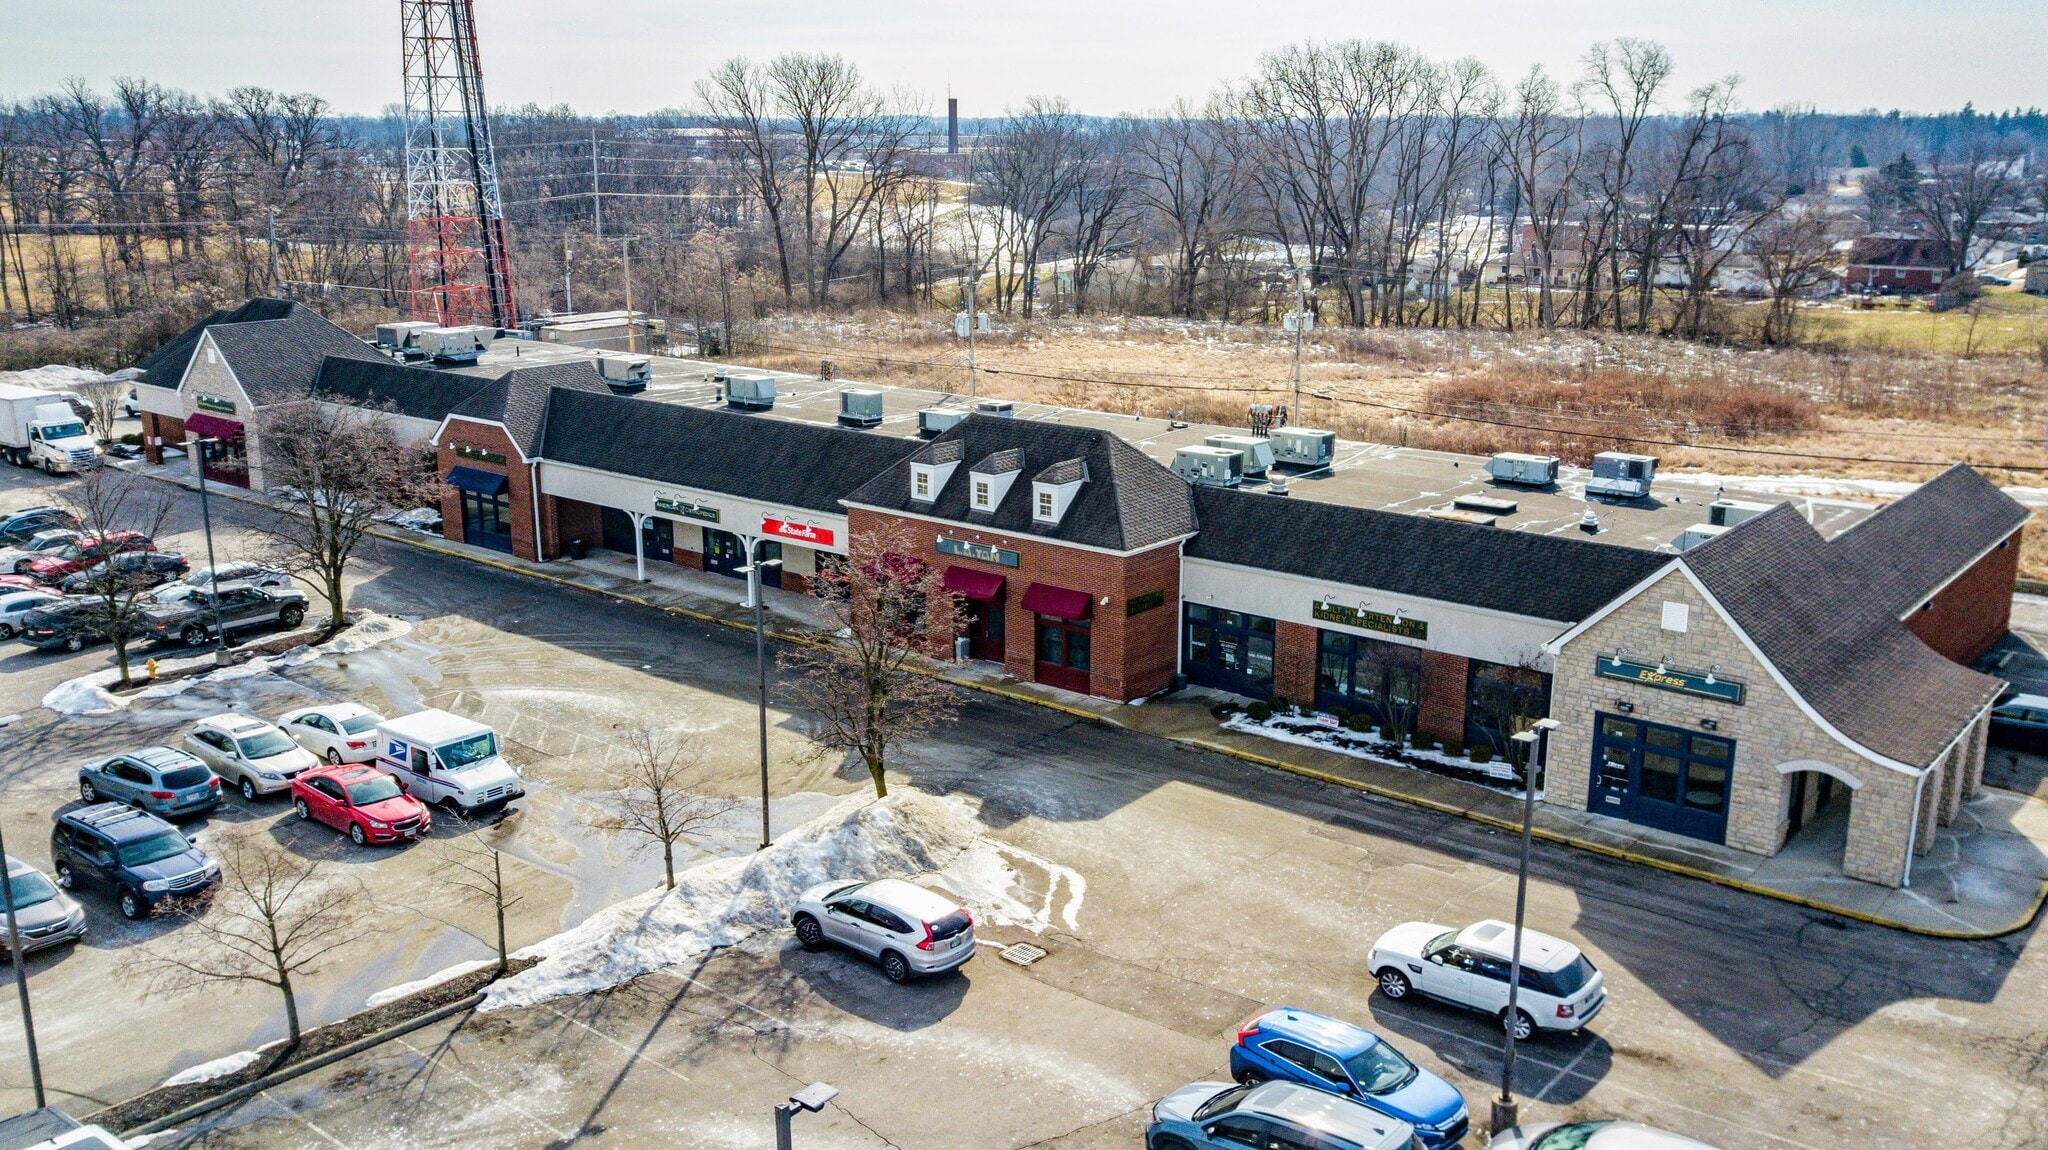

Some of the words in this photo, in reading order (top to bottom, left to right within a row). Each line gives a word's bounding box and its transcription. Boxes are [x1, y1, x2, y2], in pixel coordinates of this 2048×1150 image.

[1314, 602, 1342, 614] AULT
[1345, 608, 1415, 628] HYERTENON
[1418, 622, 1425, 631] &
[1314, 610, 1347, 623] KIDNEY
[1351, 618, 1410, 636] SPECIALISTS
